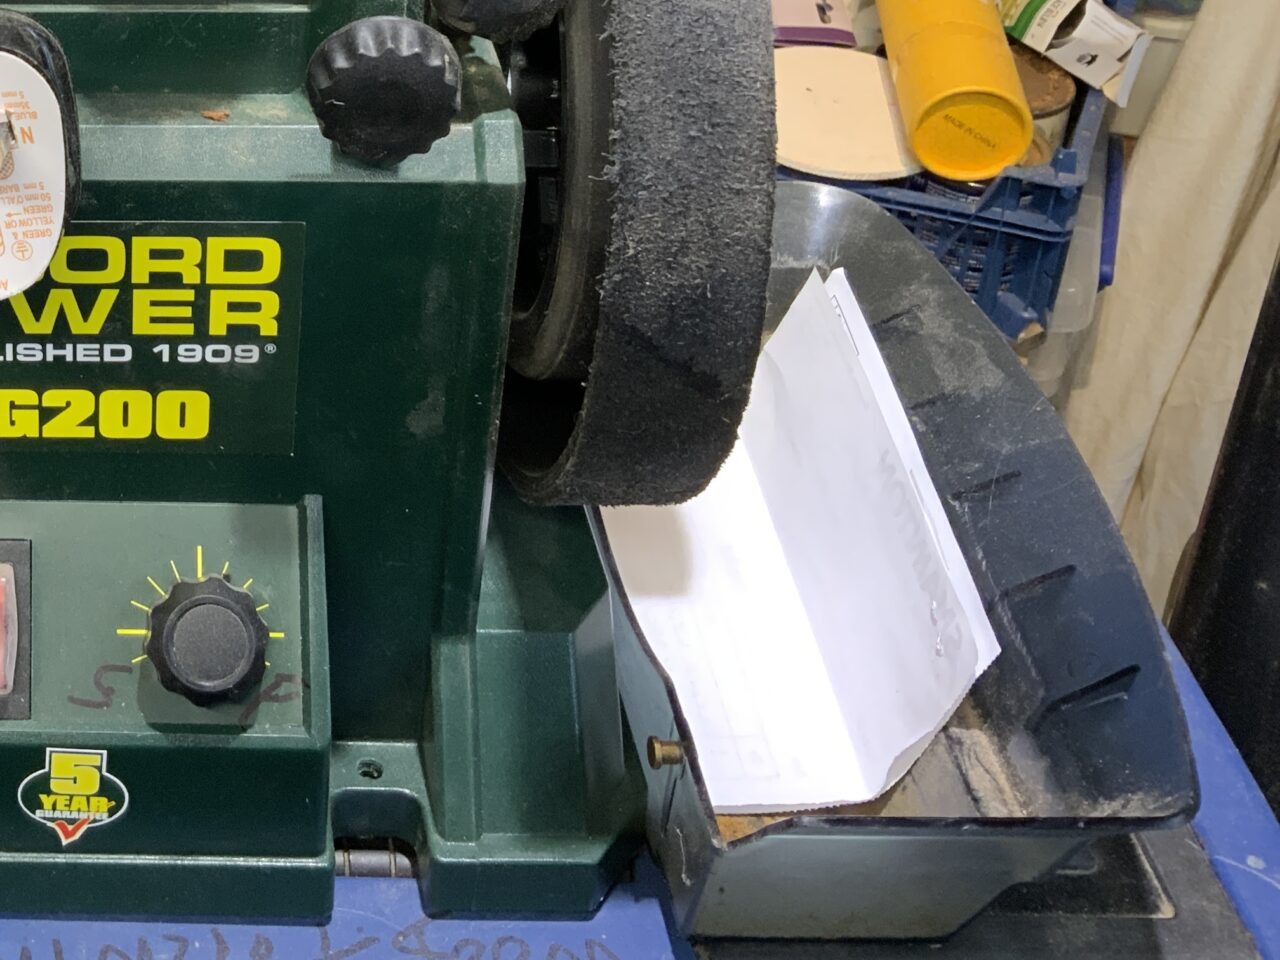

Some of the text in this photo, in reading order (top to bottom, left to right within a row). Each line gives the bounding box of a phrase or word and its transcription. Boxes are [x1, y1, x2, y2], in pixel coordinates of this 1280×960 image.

[20, 126, 35, 145] N
[23, 204, 54, 216] GREEN
[19, 216, 55, 227] YELLOW
[22, 229, 53, 239] GREEN
[50, 752, 102, 795] 5
[39, 794, 110, 812] YEAR
